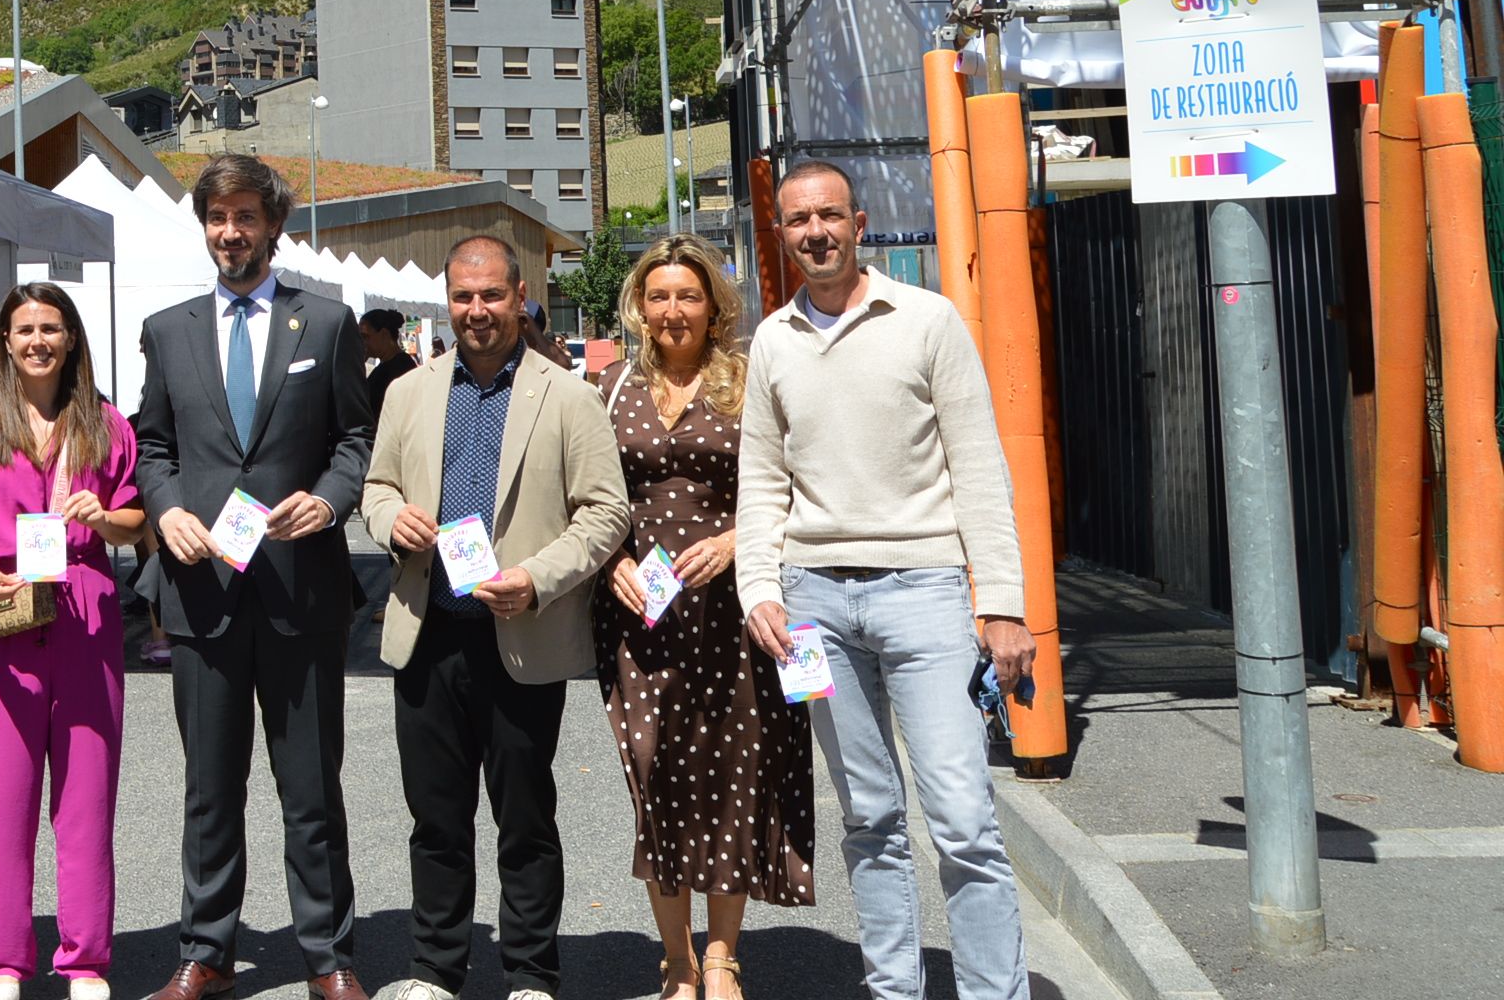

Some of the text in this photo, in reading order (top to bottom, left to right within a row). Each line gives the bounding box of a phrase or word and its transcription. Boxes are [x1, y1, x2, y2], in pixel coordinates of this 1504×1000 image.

[1192, 40, 1245, 76] ZONA
[1151, 71, 1298, 120] DE RESTAURACIÓ
